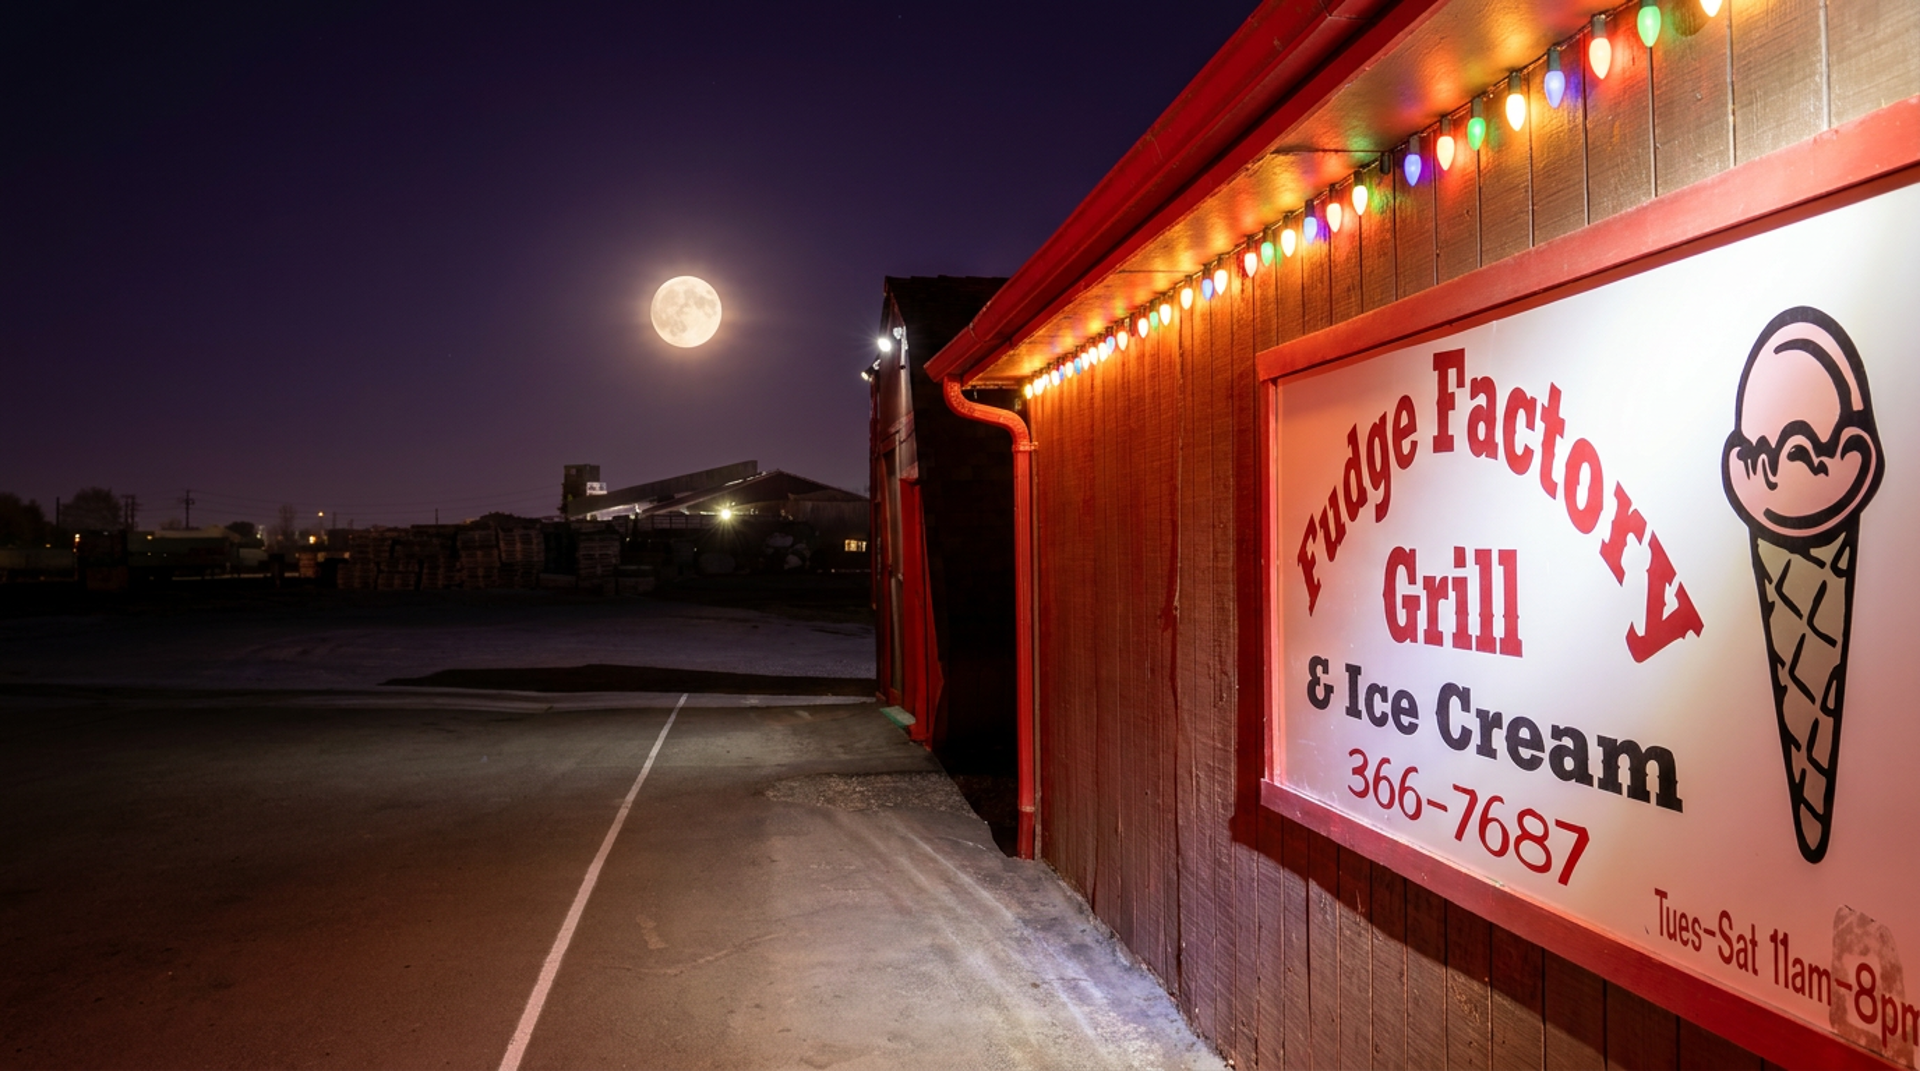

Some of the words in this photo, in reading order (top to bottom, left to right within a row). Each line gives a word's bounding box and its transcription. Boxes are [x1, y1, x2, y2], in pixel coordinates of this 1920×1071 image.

[1298, 394, 1418, 617] Fudge
[1433, 348, 1704, 663] Factory
[1383, 545, 1523, 658] Grill
[1306, 655, 1334, 710] &
[1345, 663, 1419, 735] Ice
[1436, 682, 1684, 813] Cream
[1347, 748, 1590, 886] 366-7687
[1654, 888, 1759, 976] Tues-Sat
